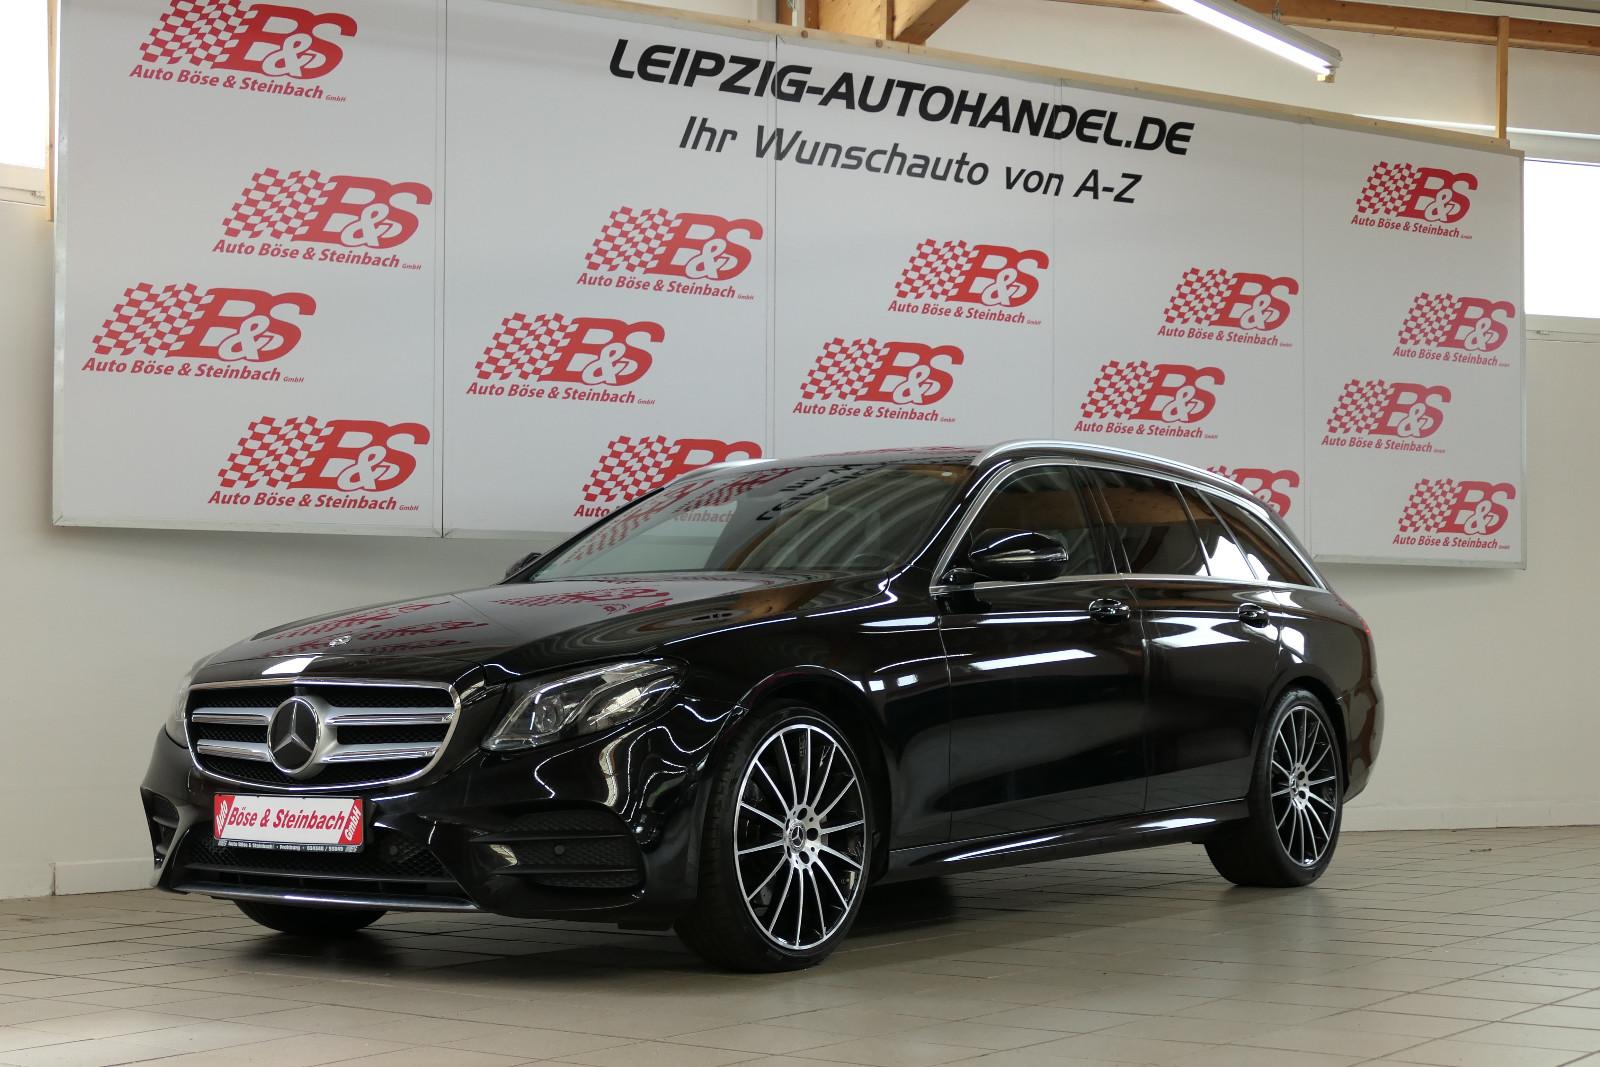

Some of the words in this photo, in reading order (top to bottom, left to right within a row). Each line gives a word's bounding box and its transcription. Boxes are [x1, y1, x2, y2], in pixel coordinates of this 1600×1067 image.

[130, 64, 173, 81] Auto
[176, 69, 219, 87] Böse
[223, 76, 237, 89] &
[240, 77, 324, 99] Steinbach
[326, 94, 346, 102] GmbH
[609, 38, 1194, 155] LEIPZIG-AUTOHANDEL.DE
[679, 116, 738, 150] Ihr
[755, 125, 989, 186] Wunschauto
[1004, 167, 1064, 196] von
[1073, 169, 1142, 204] A-Z
[1351, 214, 1375, 227] Auto
[1377, 218, 1401, 230] Böse
[1403, 222, 1410, 232] &
[1412, 222, 1460, 238] Steinbach
[212, 239, 254, 256] Auto
[258, 243, 299, 259] Böse
[302, 247, 316, 261] &
[319, 248, 400, 268] Steinbach
[402, 263, 422, 271] GmbH
[577, 272, 613, 287] Auto
[615, 276, 650, 291] Böse
[653, 280, 665, 291] &
[667, 280, 736, 299] Steinbach
[888, 300, 919, 314] Auto
[921, 303, 951, 317] Böse
[954, 307, 963, 318] &
[965, 307, 1025, 324] Steinbach
[1157, 325, 1185, 337] Auto
[1187, 327, 1214, 340] Böse
[1216, 331, 1225, 341] &
[1226, 331, 1278, 346] Steinbach
[1392, 346, 1417, 358] Auto
[1418, 349, 1442, 361] Böse
[1443, 352, 1450, 361] &
[1452, 352, 1498, 366] Steinbach
[82, 358, 127, 373] Auto
[130, 360, 174, 376] Böse
[178, 363, 193, 376] &
[194, 363, 281, 382] Steinbach
[466, 382, 504, 397] Auto
[507, 384, 545, 399] Böse
[547, 387, 560, 399] &
[562, 387, 635, 404] Steinbach
[792, 402, 826, 415] Auto
[828, 403, 861, 417] Böse
[863, 407, 874, 418] &
[875, 407, 938, 422] Steinbach
[1074, 421, 1103, 432] Auto
[1106, 423, 1134, 435] Böse
[1136, 425, 1145, 435] &
[1147, 425, 1203, 439] Steinbach
[1321, 435, 1347, 446] Auto
[1348, 437, 1373, 449] Böse
[1375, 439, 1383, 449] &
[1384, 439, 1433, 453] Steinbach
[208, 490, 250, 505] Auto
[253, 492, 295, 507] Böse
[299, 494, 312, 507] &
[314, 494, 397, 510] Steinbach
[1392, 534, 1416, 545] Auto
[1418, 535, 1441, 547] Böse
[1442, 537, 1450, 547] &
[1451, 537, 1498, 549] Steinbach
[228, 806, 258, 826] Böse
[260, 808, 271, 827] &
[273, 809, 345, 829] Steinbach
[344, 806, 361, 840] GmbH
